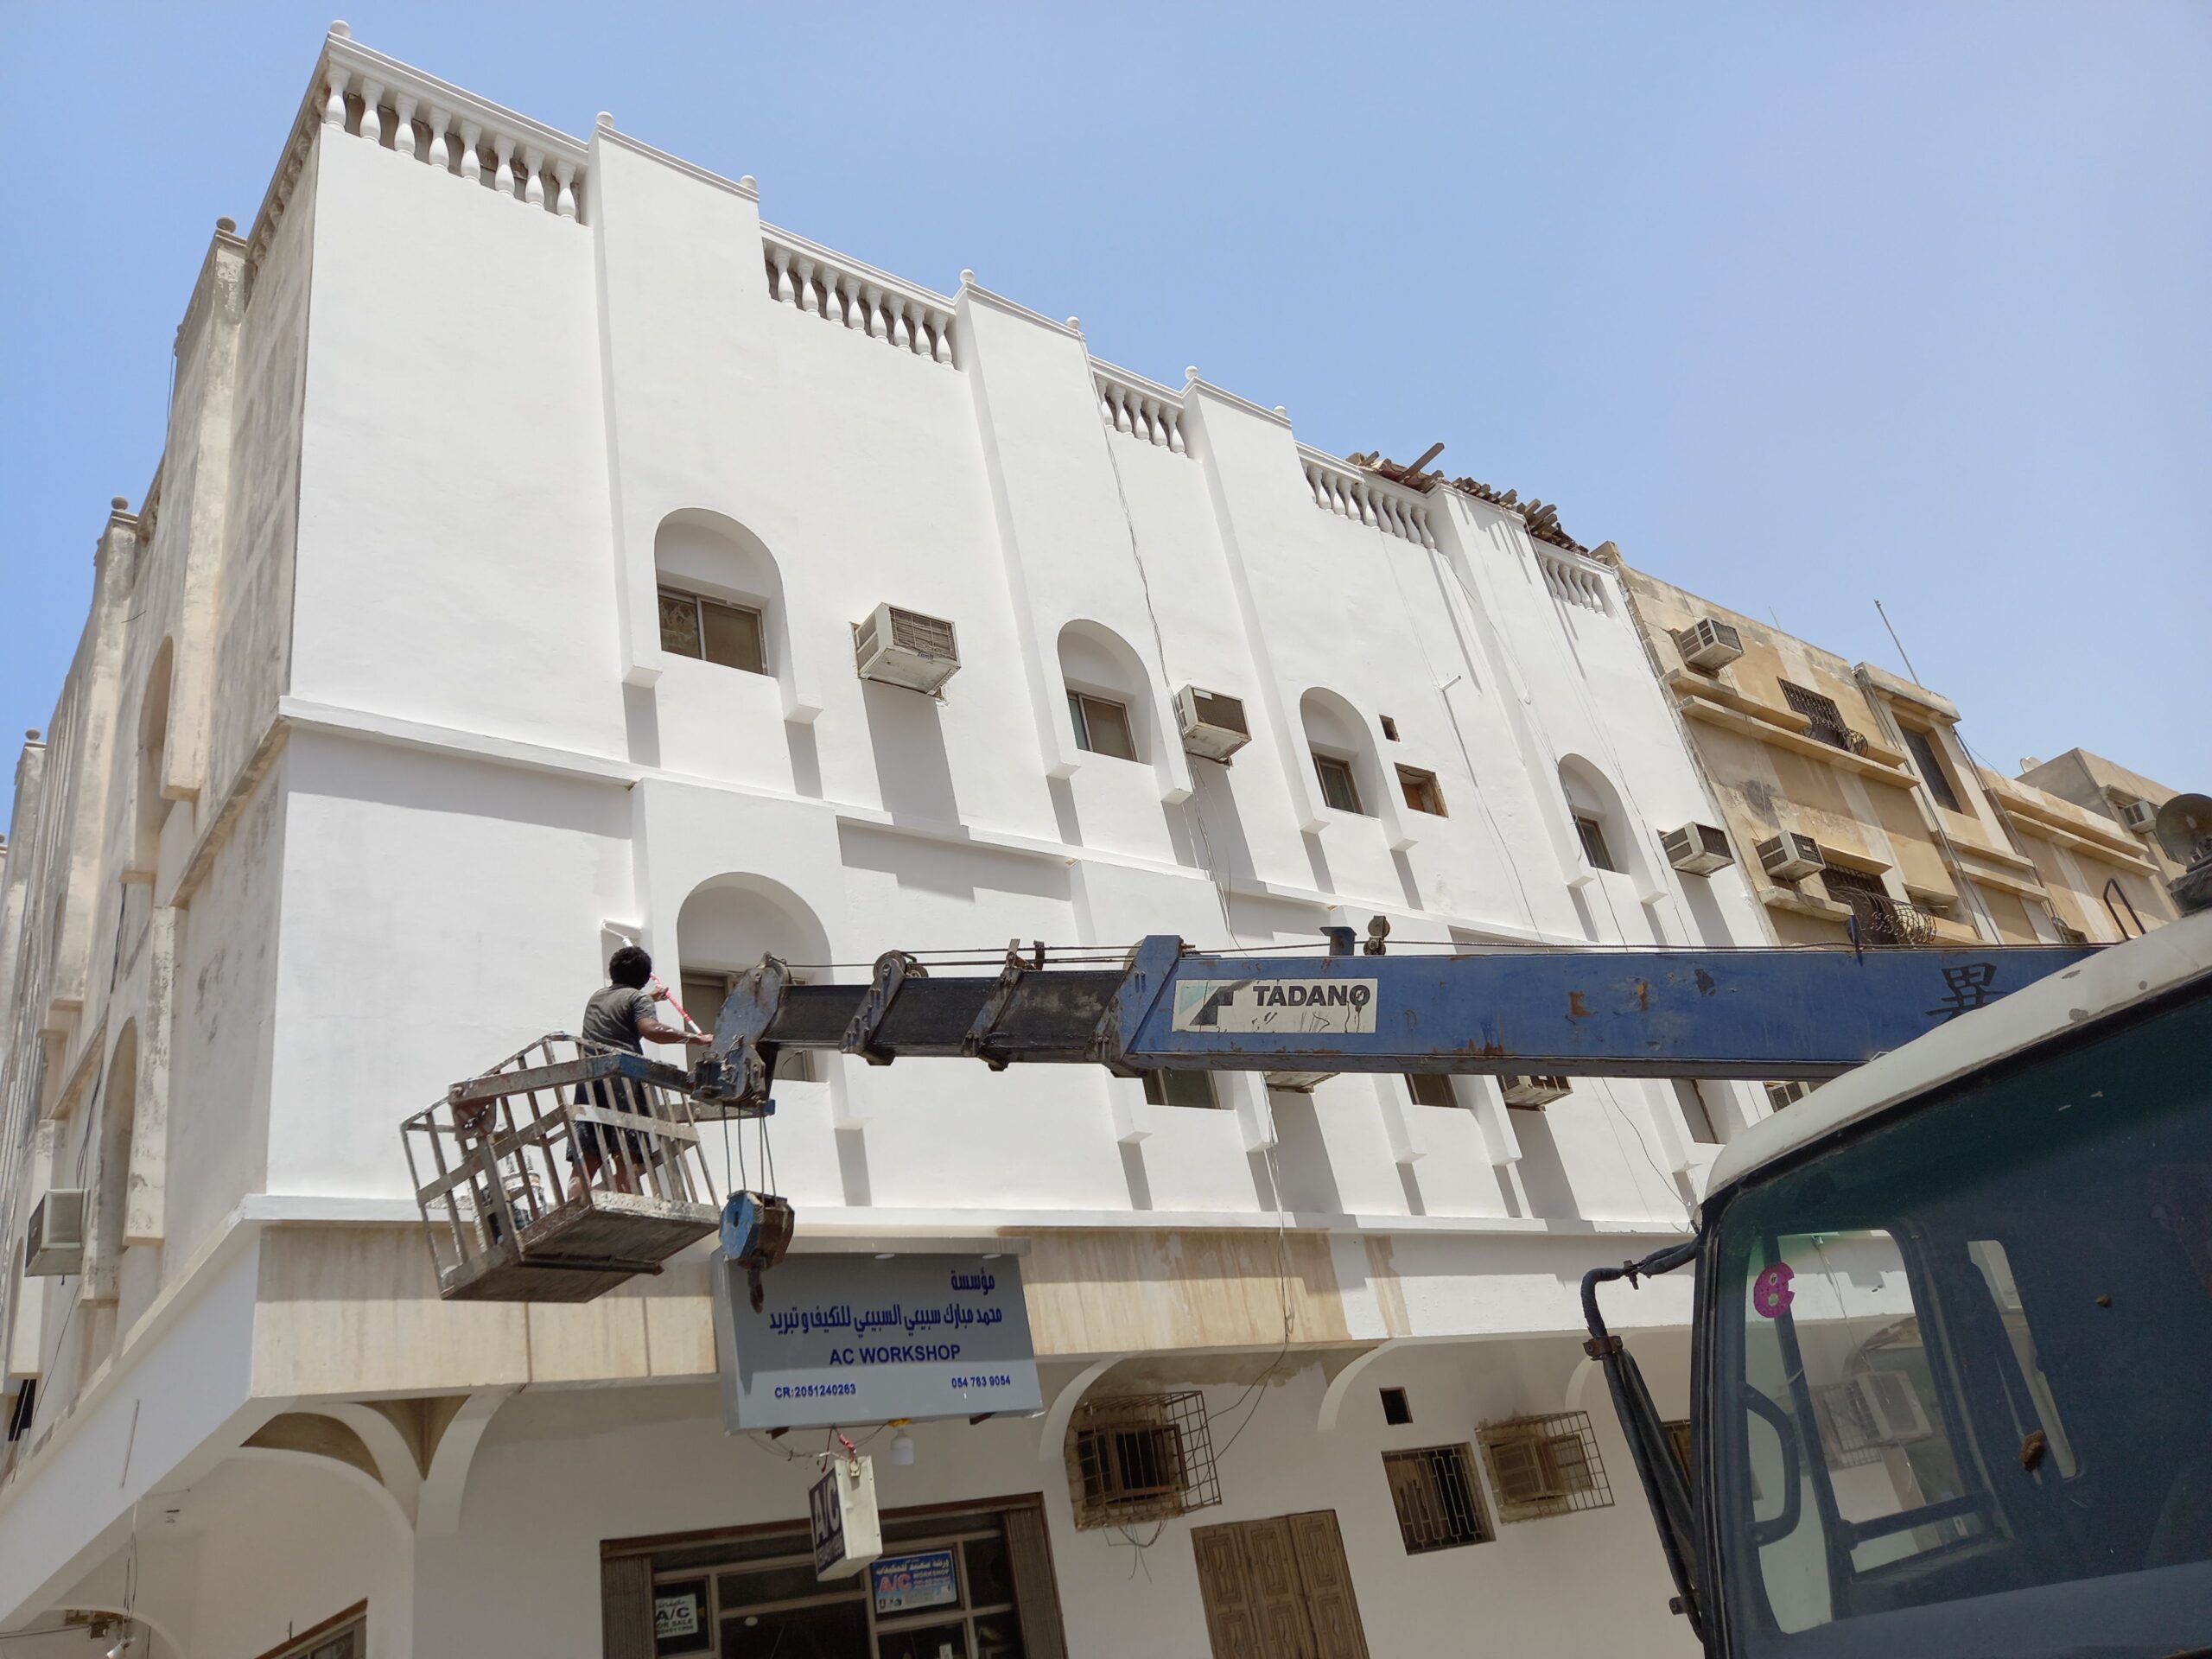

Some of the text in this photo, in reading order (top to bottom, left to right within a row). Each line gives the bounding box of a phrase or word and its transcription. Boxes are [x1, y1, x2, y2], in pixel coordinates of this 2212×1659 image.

[1253, 984, 1370, 1007] TADANO
[950, 1267, 995, 1295] مؤسسة
[853, 1304, 902, 1338] السبيعي
[903, 1308, 942, 1338] سبيعي
[944, 1303, 974, 1330] مبارك
[976, 1307, 1002, 1326] محمد
[830, 1344, 961, 1366] AC WORKSHOP
[951, 1376, 968, 1389] 054
[988, 1374, 1011, 1387] 9054
[814, 1475, 841, 1544] A/C
[879, 1573, 912, 1593] A/C
[657, 1607, 690, 1620] A/C
[671, 1618, 693, 1627] SALE
